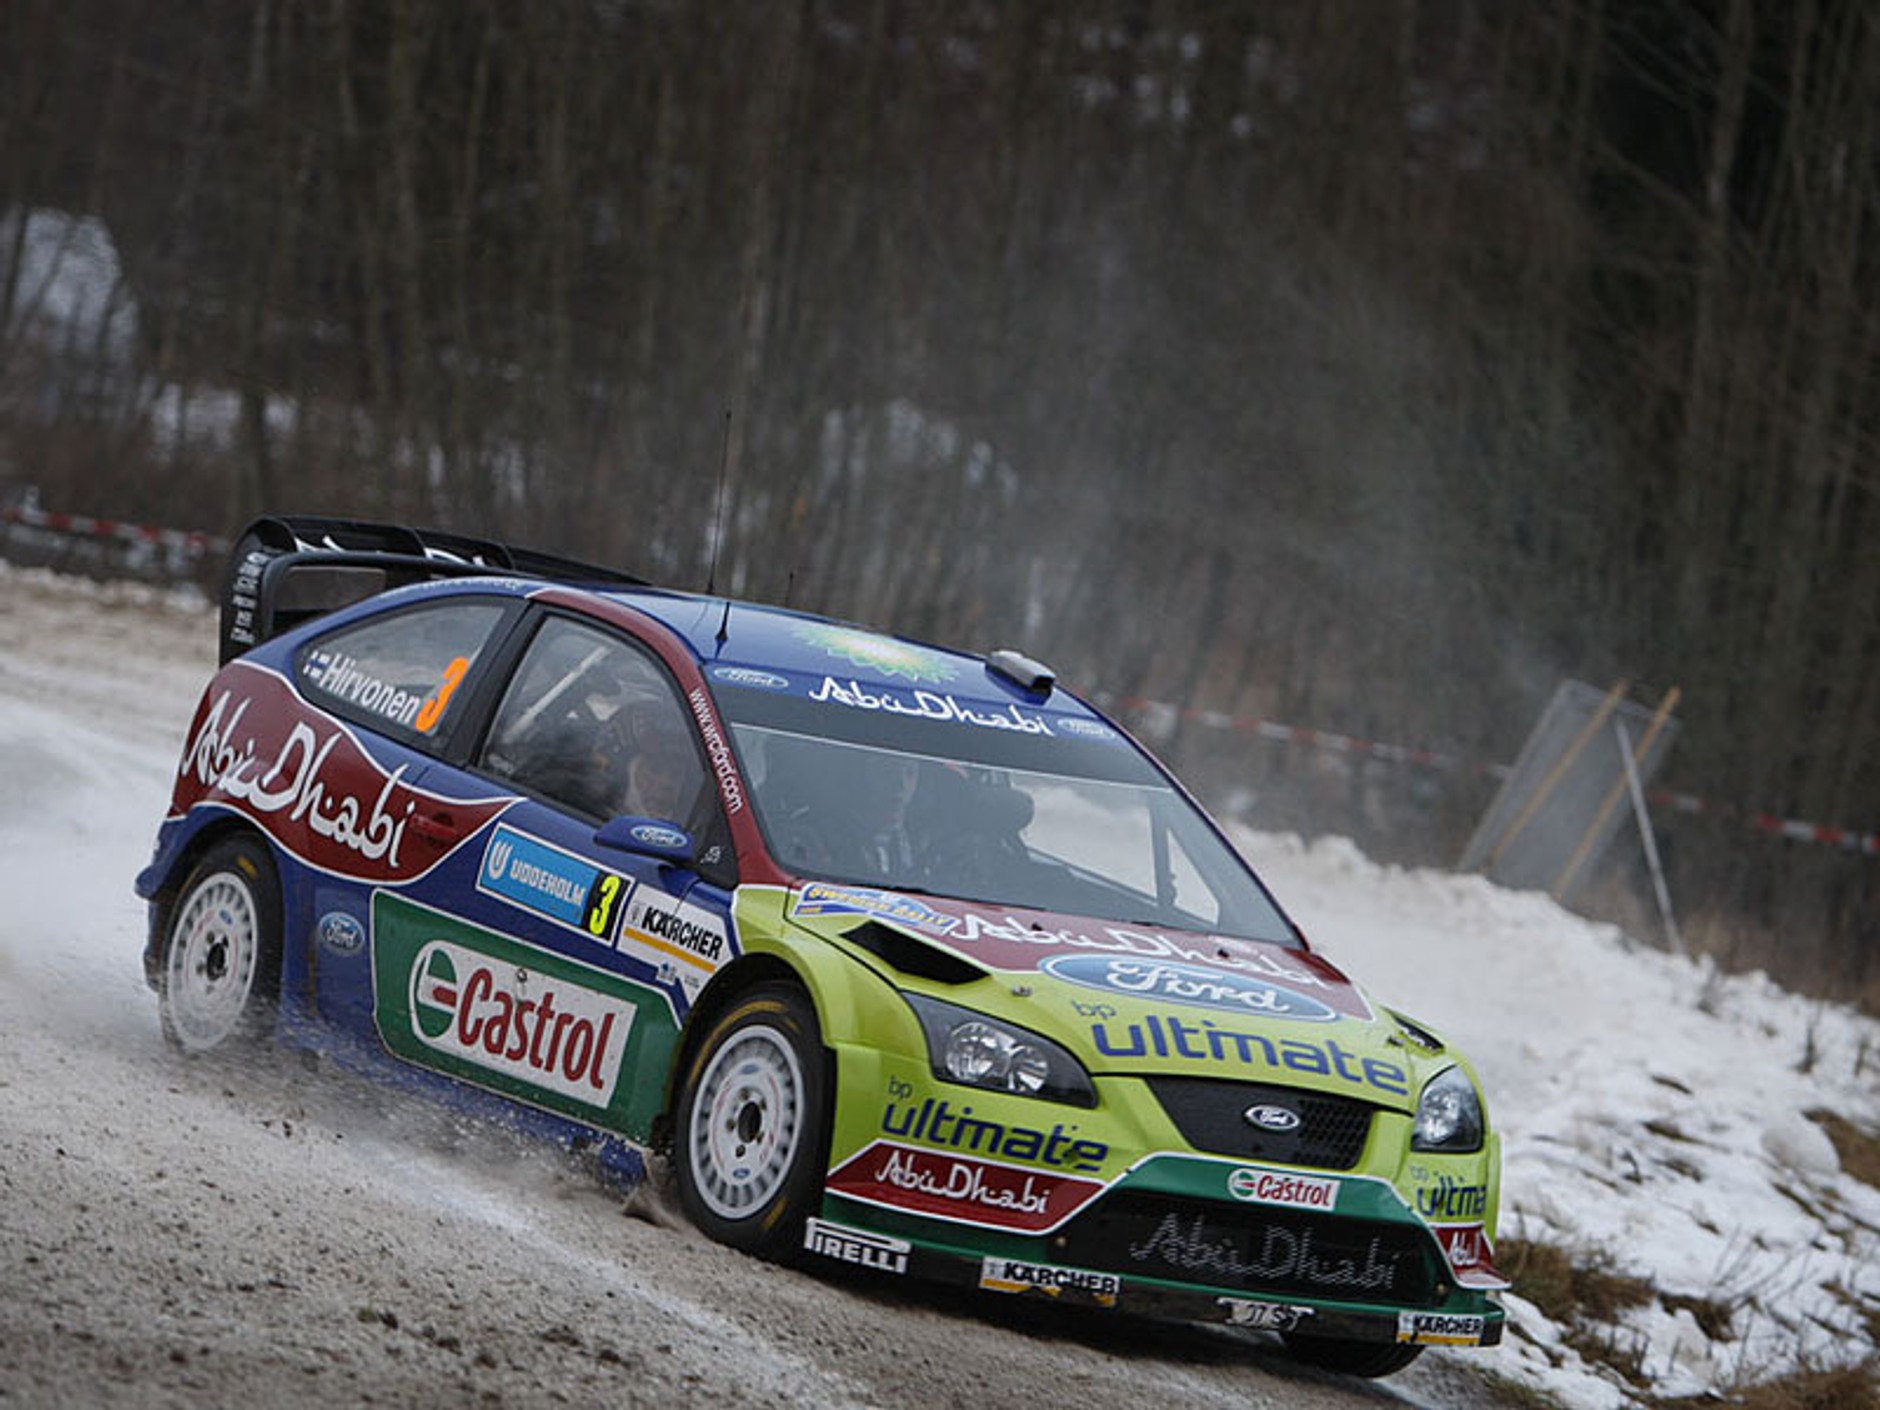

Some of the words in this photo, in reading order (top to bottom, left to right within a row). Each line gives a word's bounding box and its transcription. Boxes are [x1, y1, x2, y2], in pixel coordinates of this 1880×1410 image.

[318, 652, 421, 725] Hirvonen
[415, 656, 469, 732] 3
[641, 827, 682, 846] Ford
[509, 858, 586, 907] UDDEHOLM
[589, 875, 621, 936] 3
[327, 920, 359, 948] Ford
[1072, 1000, 1116, 1020] bp
[1107, 958, 1290, 1013] Ford
[458, 967, 616, 1090] Castrol
[1091, 1015, 1409, 1097] ultimate
[888, 1077, 913, 1099] bp
[881, 1098, 1109, 1171] ultimate
[1259, 1108, 1287, 1126] Ford
[1256, 1174, 1332, 1207] Castrol
[804, 1217, 912, 1274] PIRELLI
